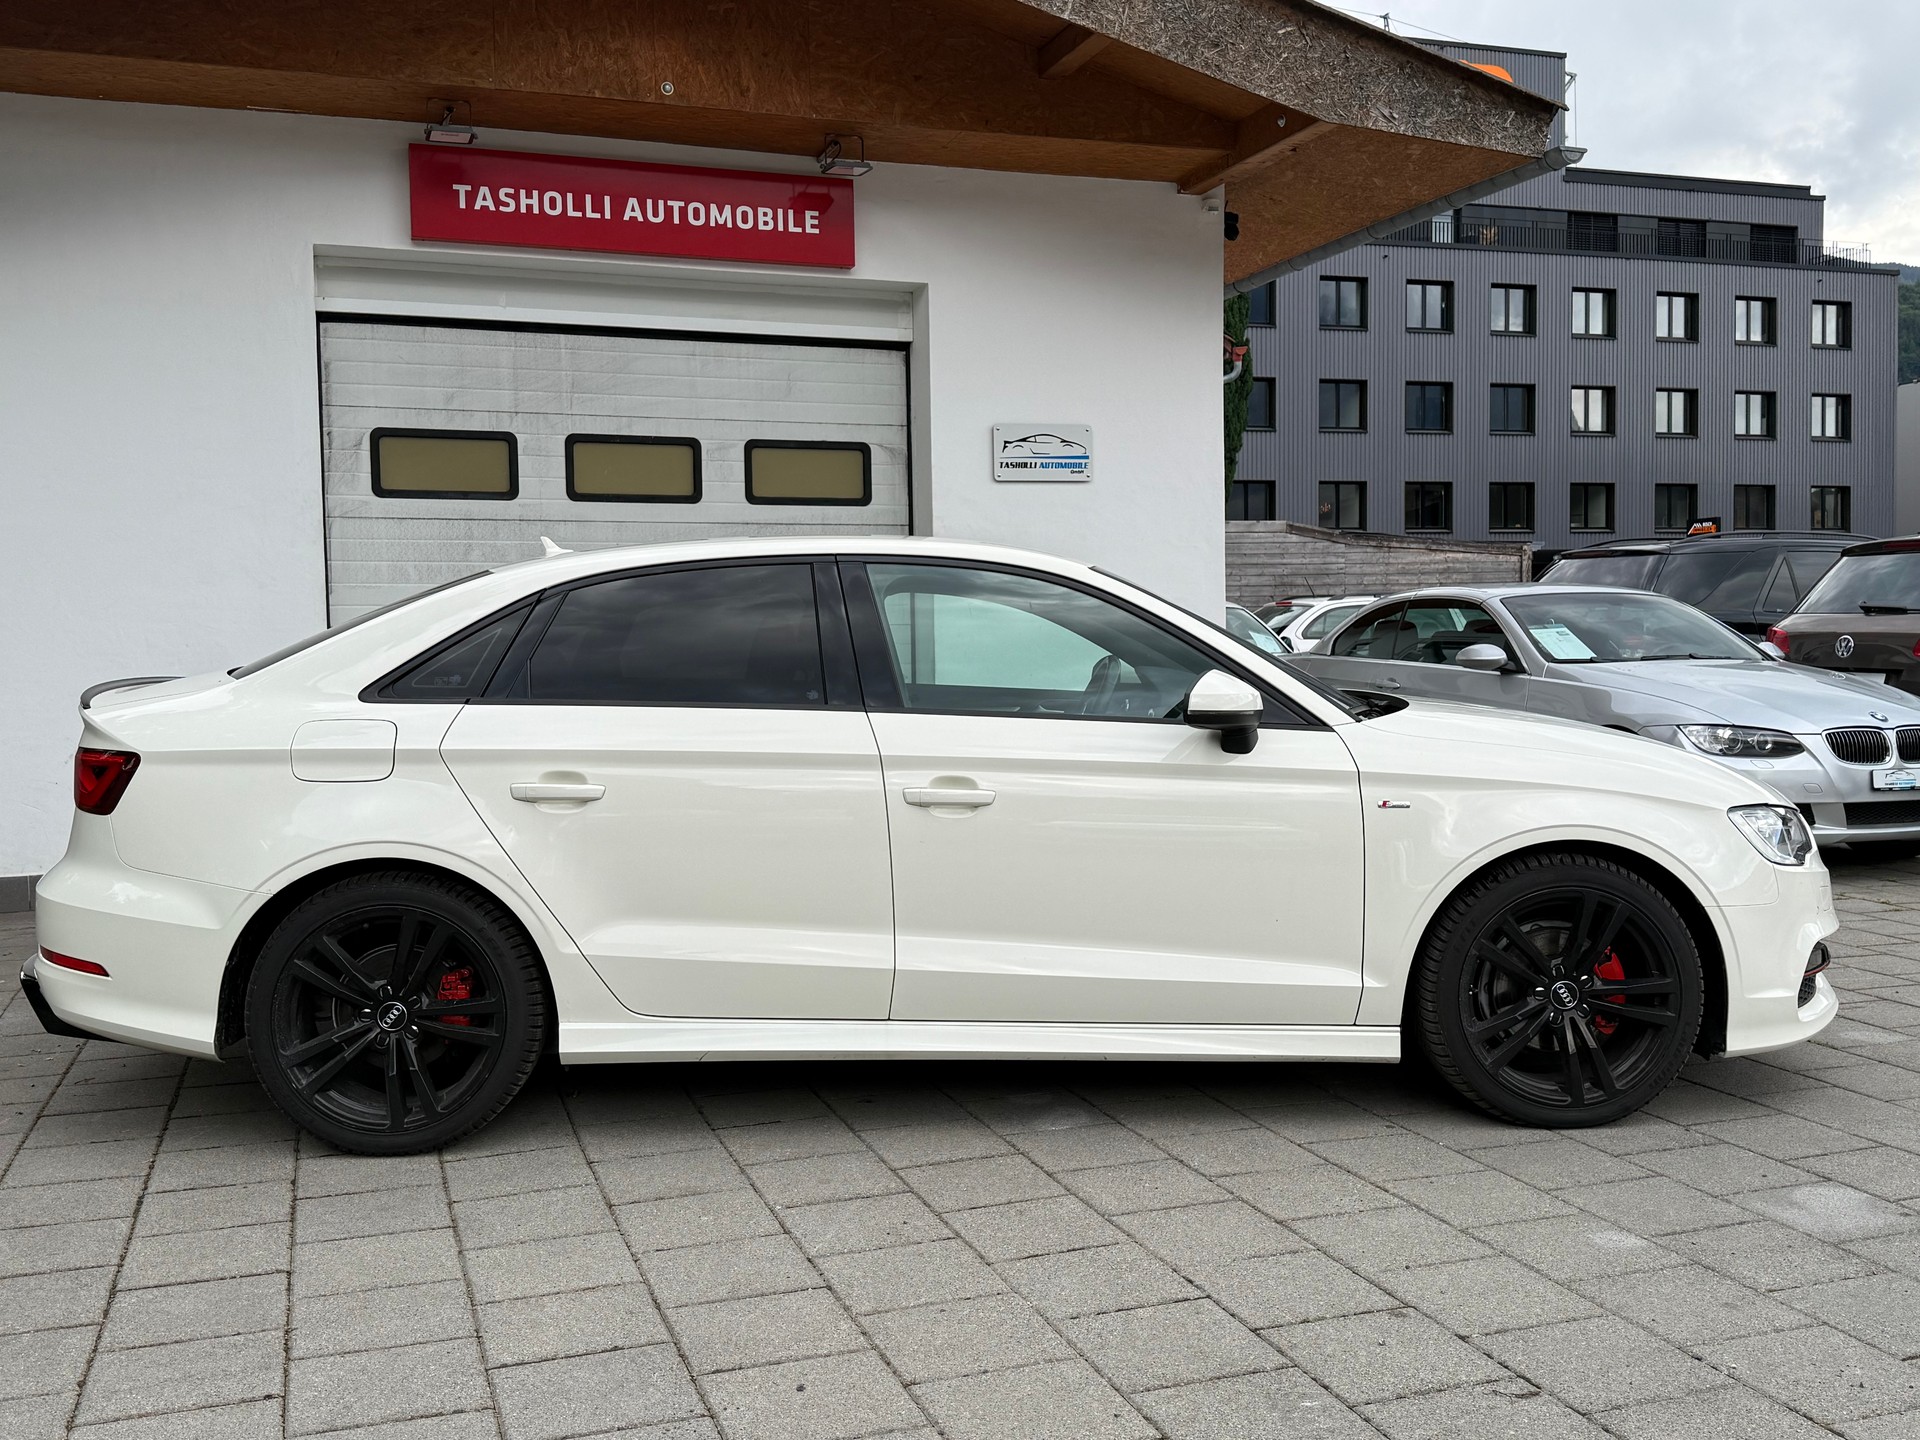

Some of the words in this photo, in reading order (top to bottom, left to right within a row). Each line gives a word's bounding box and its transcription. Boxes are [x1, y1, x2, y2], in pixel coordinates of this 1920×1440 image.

[452, 183, 612, 220] TASHOLLI
[623, 197, 820, 234] AUTOMOBILE
[999, 461, 1037, 469] TASHOLLI
[1039, 461, 1089, 470] AUTOMOBILE
